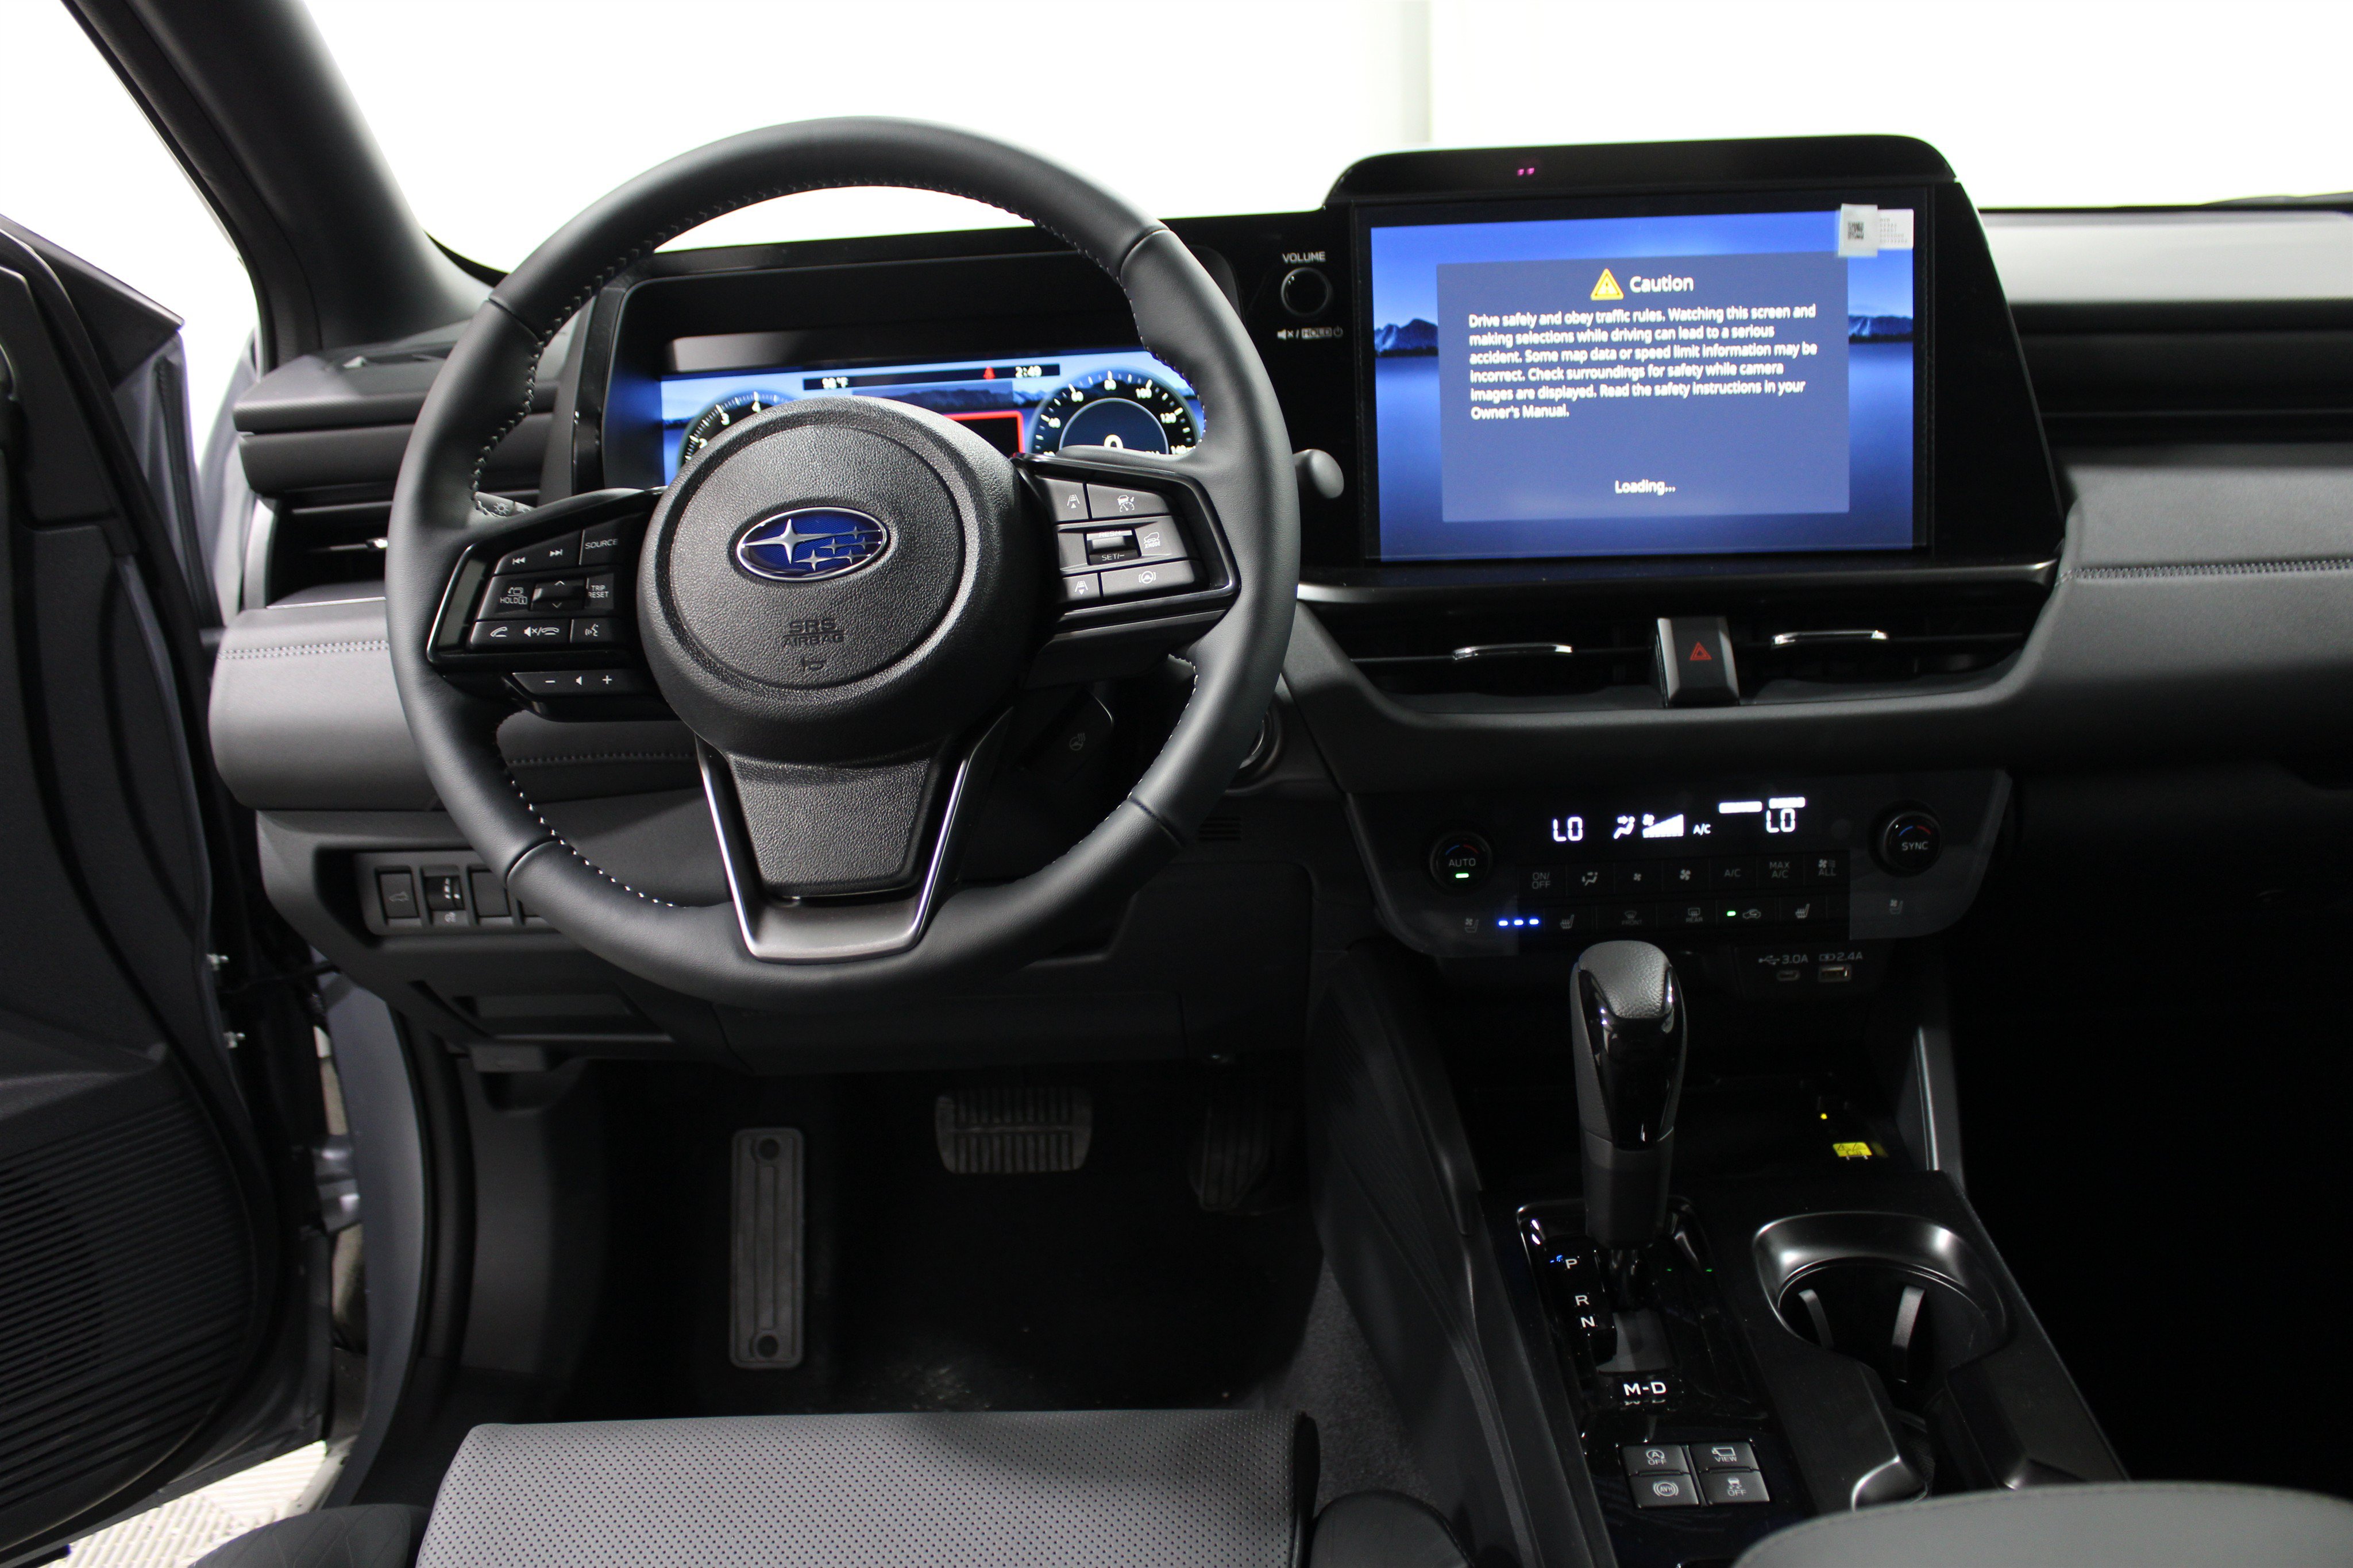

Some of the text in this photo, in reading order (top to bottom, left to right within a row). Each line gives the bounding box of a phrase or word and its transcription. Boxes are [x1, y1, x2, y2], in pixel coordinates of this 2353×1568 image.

[1282, 251, 1326, 264] VOLUME
[1630, 275, 1694, 292] Caution
[1469, 303, 1816, 328] Drive safely and obey traffic rules. Watching this screen and
[1469, 324, 1775, 348] making selections while driving can lead to a serious
[1469, 341, 1818, 364] accident. Some map data or speed limit information may be
[1470, 361, 1784, 383] incorrect. Check surroundings for safety while camera
[1104, 379, 1116, 391] 80
[1136, 388, 1152, 399] 100
[1471, 380, 1806, 404] images are displayed. Read the safety instructions in your
[1471, 403, 1569, 419] Owner's Manual.
[721, 412, 730, 425] 3
[1160, 412, 1176, 423] 120
[1615, 479, 1676, 496] Loading...
[584, 538, 618, 549] SOURCE
[789, 619, 837, 633] SRS
[1766, 808, 1796, 833] LO
[1553, 816, 1584, 842] LO
[1693, 822, 1711, 836] A/C
[1901, 841, 1929, 851] SYNC
[1448, 858, 1476, 868] AUTO
[1769, 861, 1790, 870] MAX
[1532, 872, 1550, 881] ON/
[1724, 868, 1741, 878] A/C
[1770, 870, 1789, 879] A/C
[1818, 868, 1837, 877] ALL
[1532, 880, 1551, 890] OFF
[1781, 951, 1863, 964] 3.0A 2.4A
[1565, 1258, 1579, 1270] P
[1575, 1295, 1590, 1306] R
[1580, 1316, 1596, 1328] N
